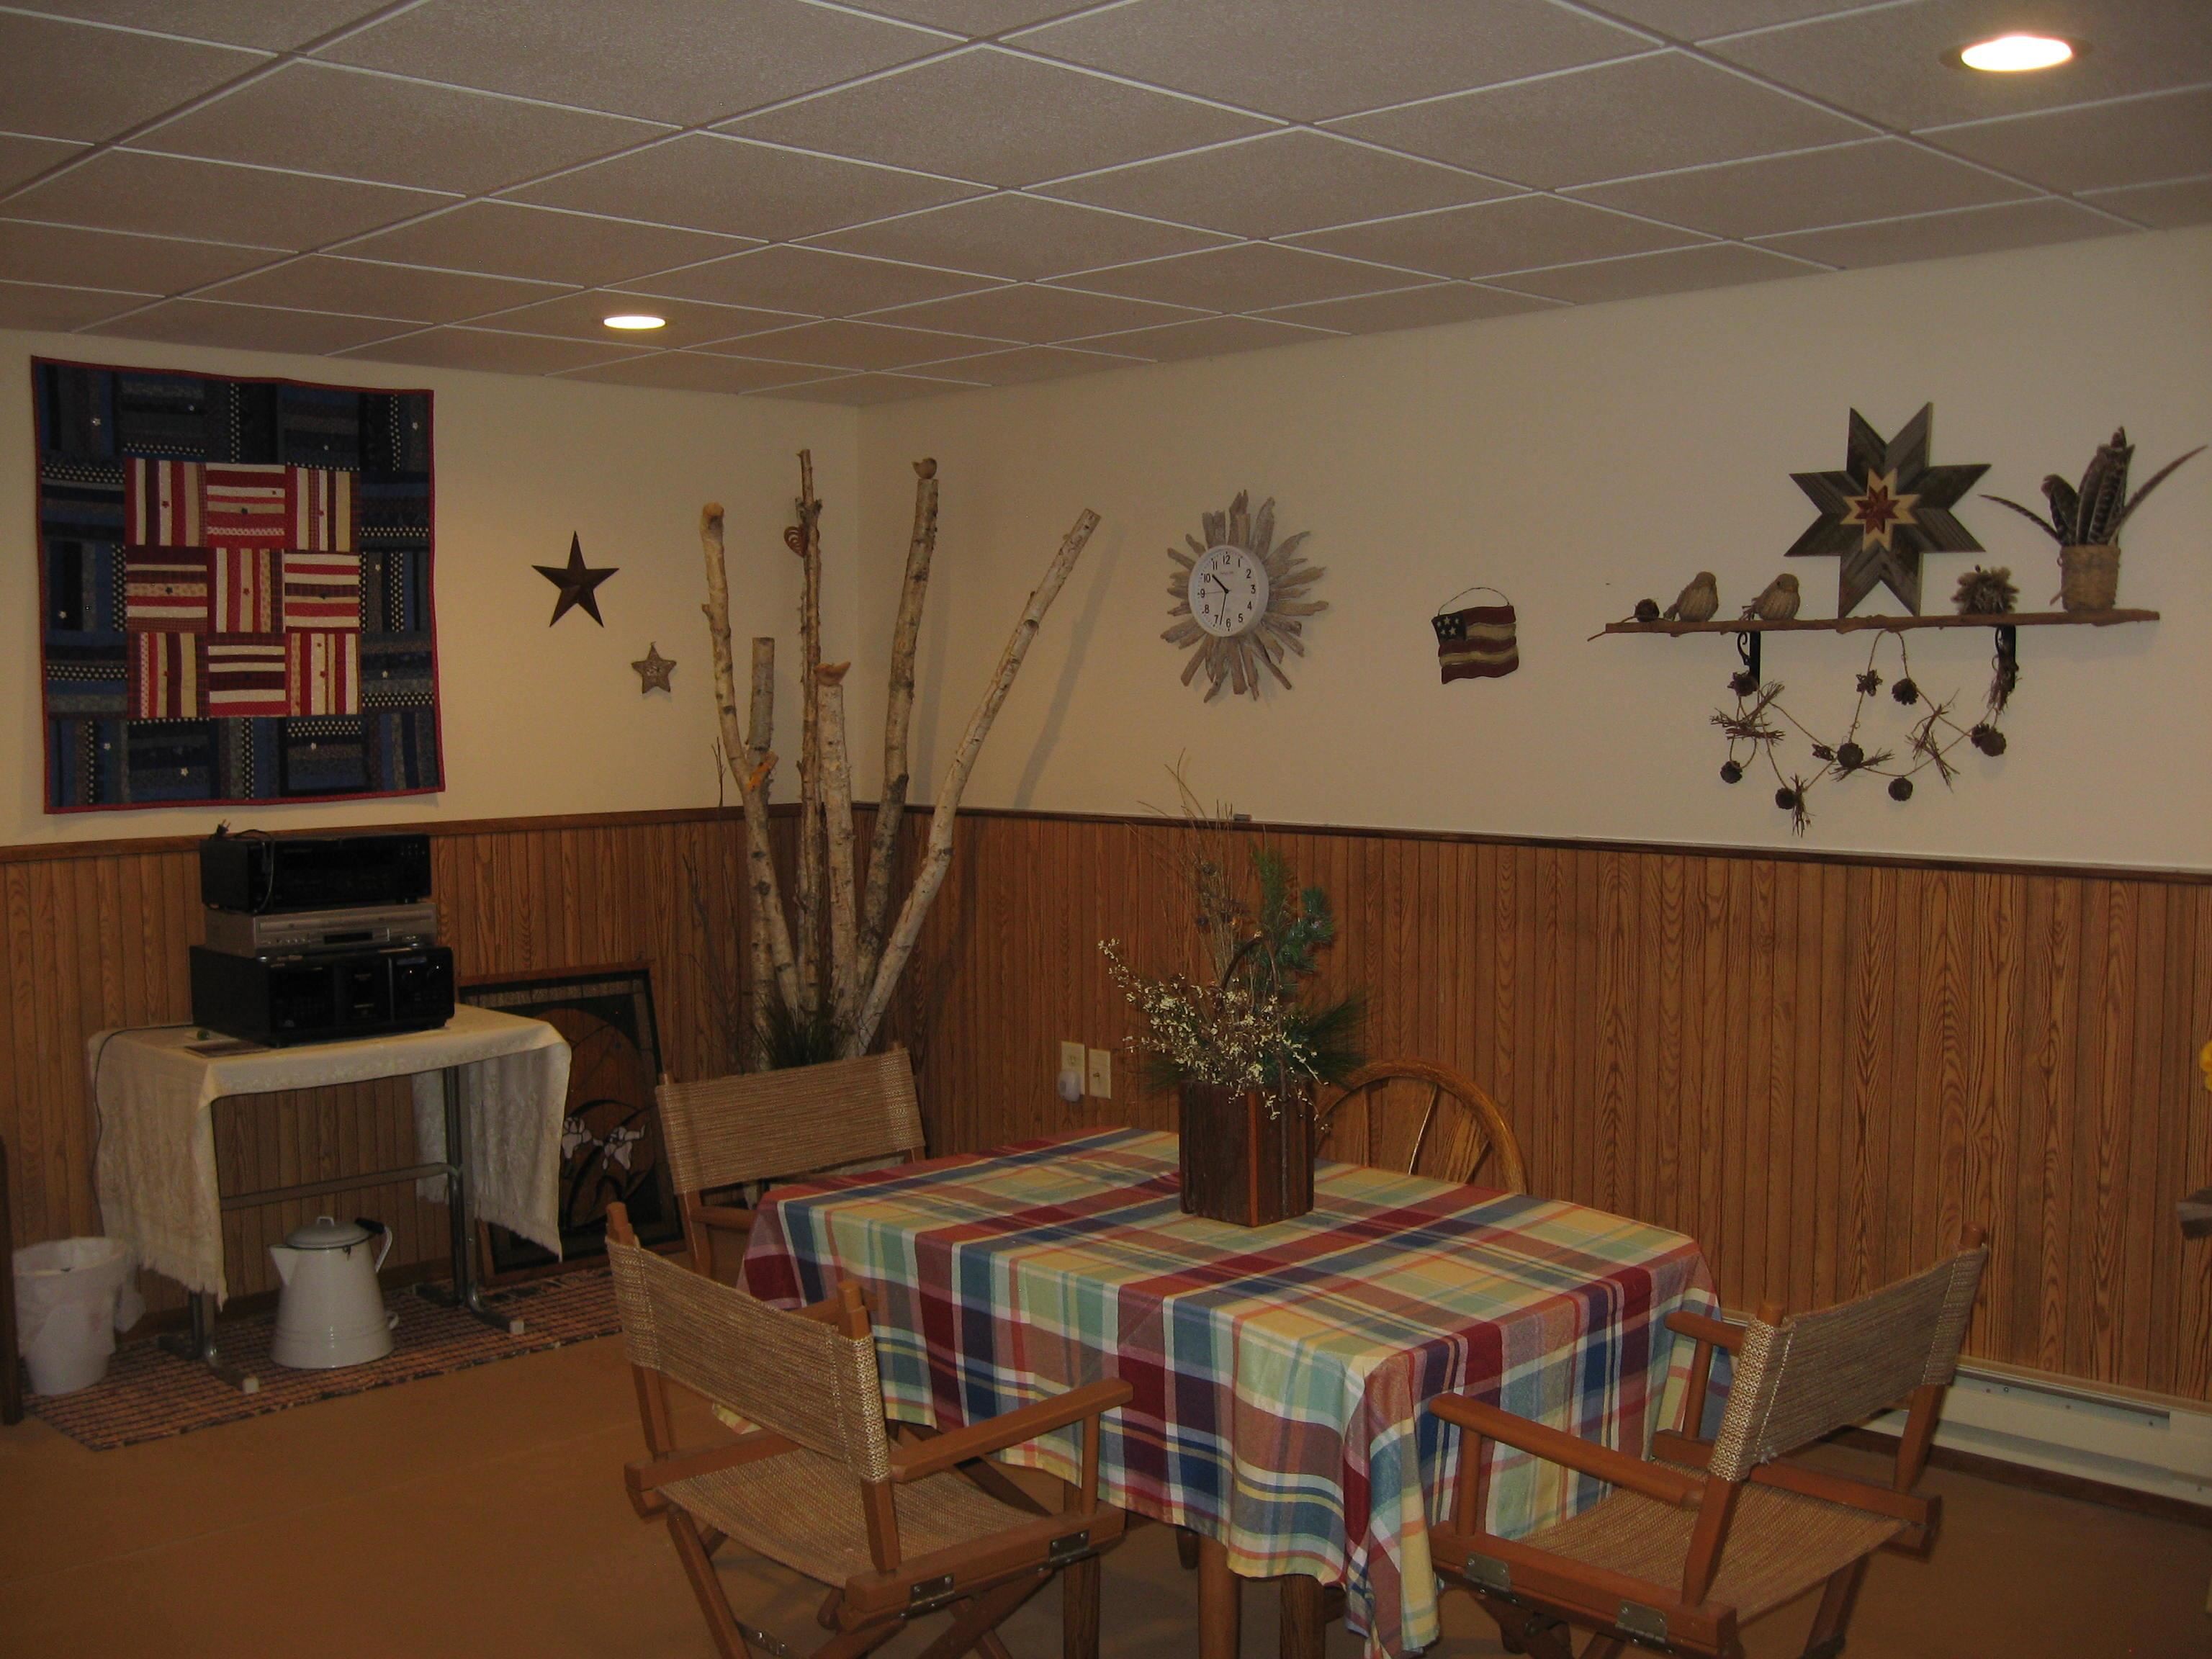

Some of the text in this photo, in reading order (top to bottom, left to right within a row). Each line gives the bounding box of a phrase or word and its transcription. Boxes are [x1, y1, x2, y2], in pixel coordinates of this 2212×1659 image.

[1223, 554, 1230, 565] 12
[1213, 561, 1218, 570] 11
[1203, 573, 1210, 583] 10
[1246, 569, 1251, 579] 2
[1200, 589, 1205, 598] 9
[1251, 585, 1256, 594] 3
[1205, 605, 1210, 613] 8
[1247, 601, 1252, 611] 4
[1214, 615, 1219, 624] 7
[1238, 613, 1244, 622] 5
[1226, 619, 1231, 628] 6
